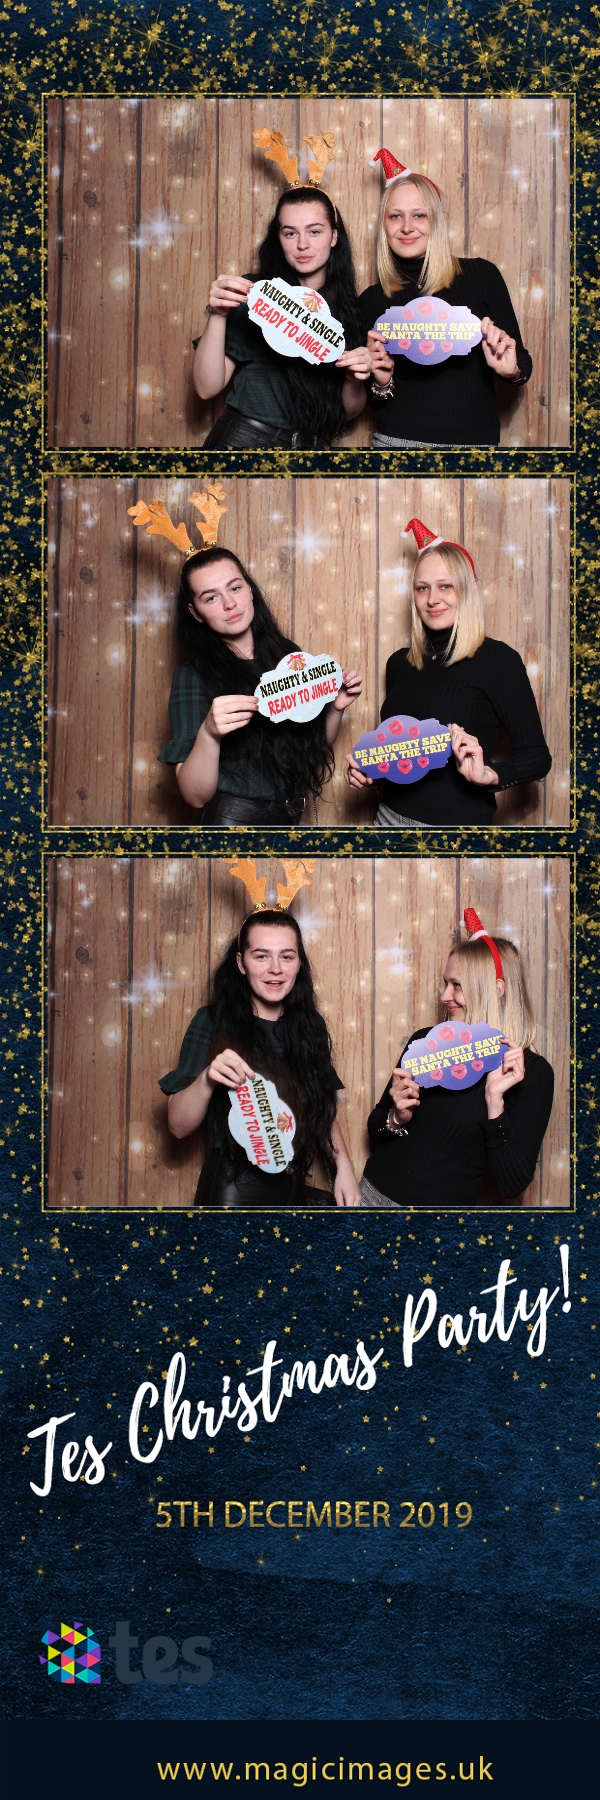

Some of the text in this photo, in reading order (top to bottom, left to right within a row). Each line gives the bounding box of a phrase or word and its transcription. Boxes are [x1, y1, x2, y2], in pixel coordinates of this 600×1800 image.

[251, 298, 331, 362] READY TO JINGLE
[259, 280, 344, 348] NAUGHTY & SINGLE
[376, 322, 481, 332] BE NAUGHTY SAVE
[381, 331, 475, 341] SANTA THE TRIP
[259, 660, 337, 698] NAUGHTY & SINGLE
[267, 677, 339, 717] READY TO JINGLE
[354, 732, 452, 760] BE NAUGHTY SAVE
[360, 742, 448, 767] SANTA THE TRIP
[403, 1057, 419, 1069] BE
[419, 1043, 473, 1065] NAUGHTY
[411, 1044, 501, 1076] SANTA THE TRIP
[235, 1085, 270, 1166] READY TO JINGLE
[251, 1079, 287, 1167] NAUGHTY & SINGLE
